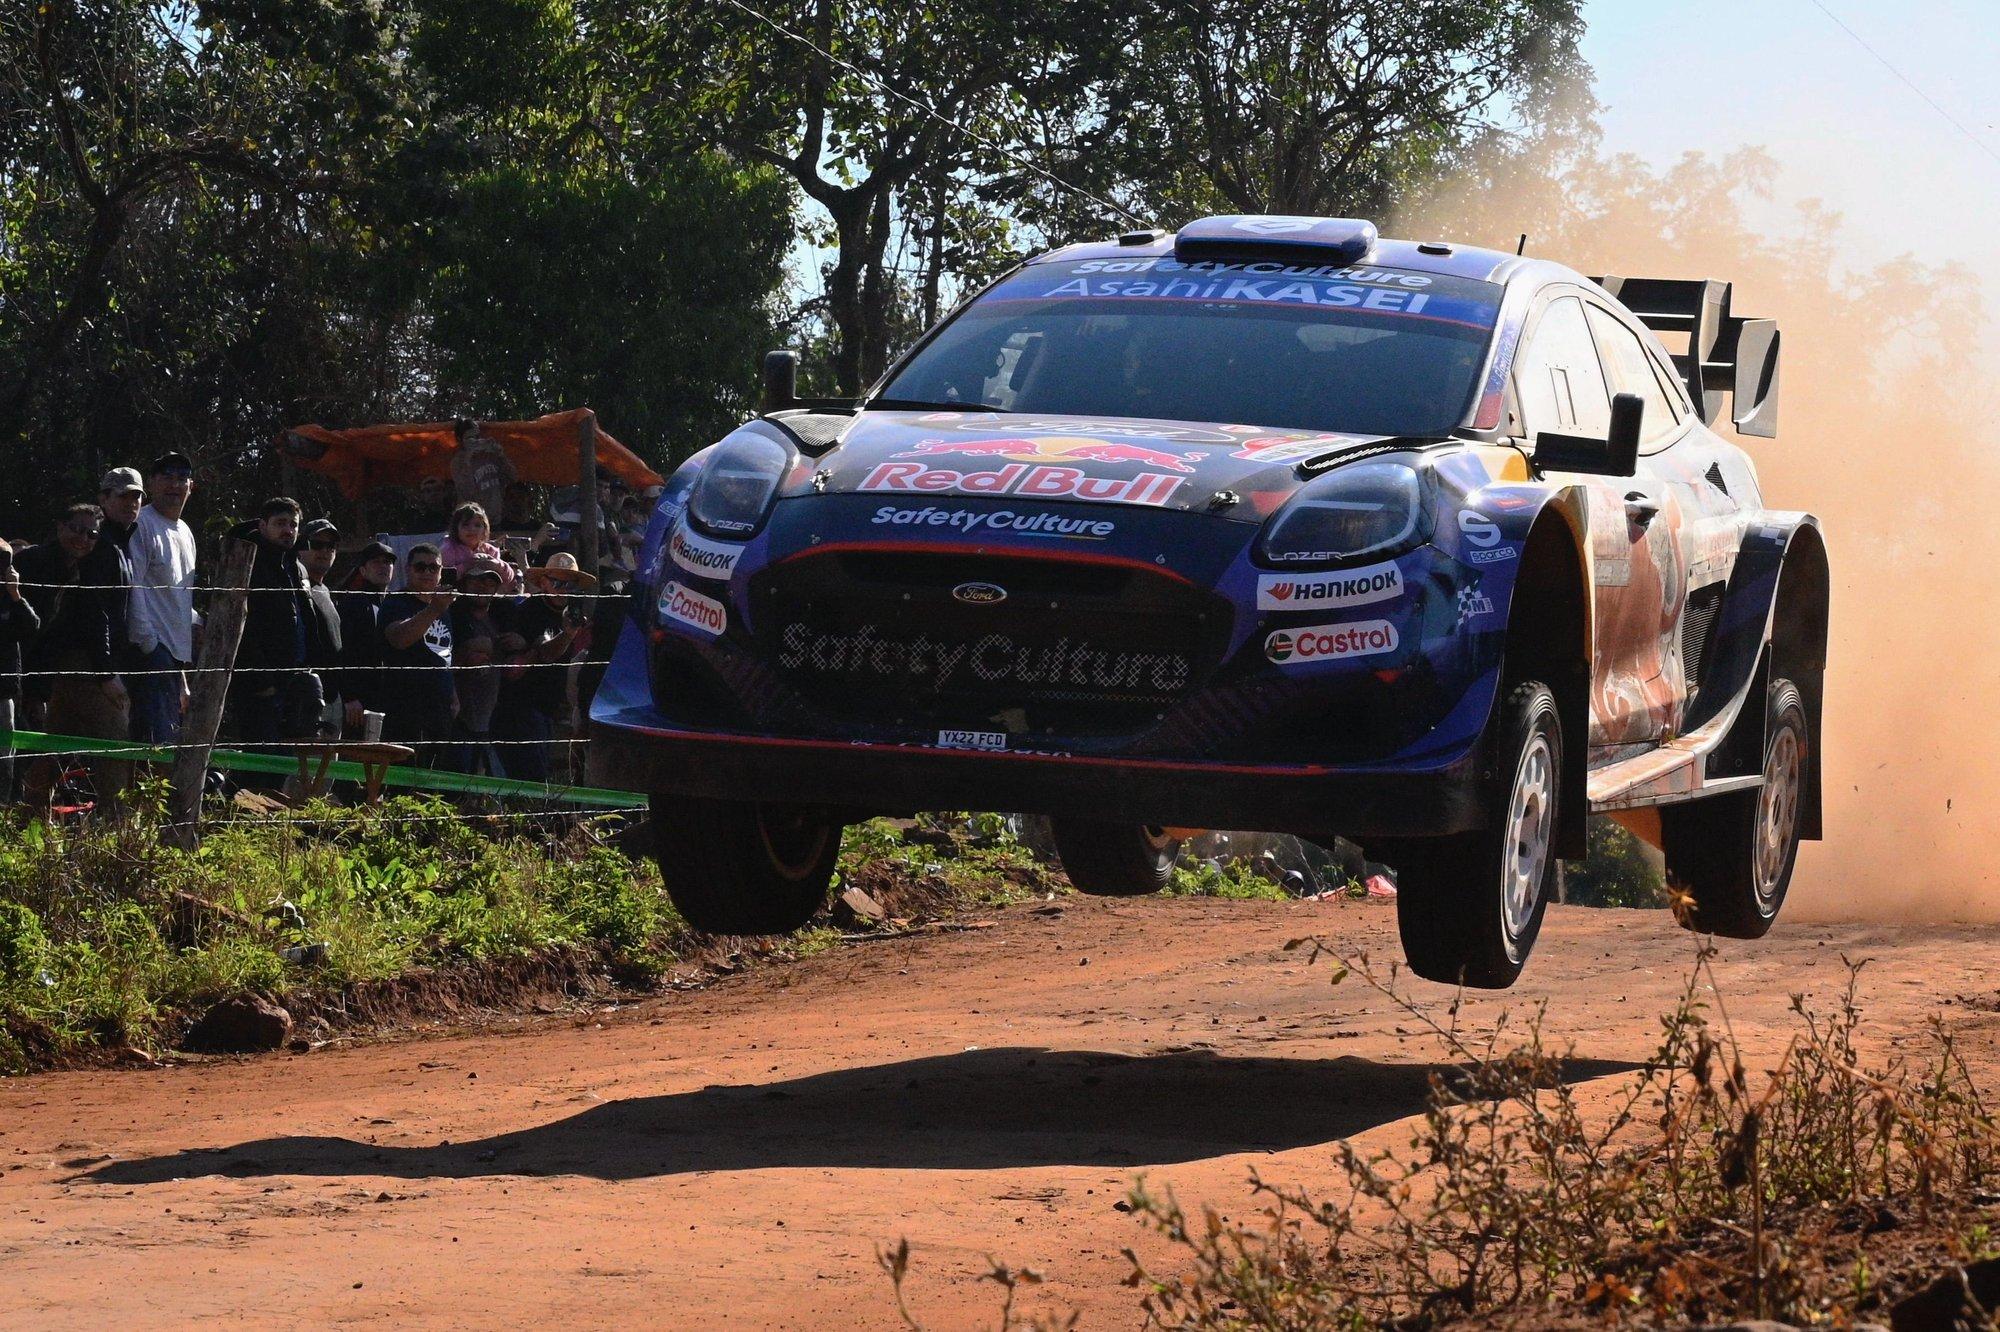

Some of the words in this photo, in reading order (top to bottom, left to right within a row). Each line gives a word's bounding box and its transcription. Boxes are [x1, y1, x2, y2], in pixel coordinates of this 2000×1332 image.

[1071, 259, 1433, 287] SafetyCulture
[857, 462, 1025, 495] Red
[1013, 465, 1187, 505] Bull
[871, 505, 1115, 537] SafetyCulture
[1472, 547, 1514, 562] sparco
[963, 586, 995, 600] Ford
[671, 591, 723, 631] Castrol
[779, 622, 1189, 691] SafetyCulture
[1295, 625, 1393, 657] Castrol
[943, 732, 975, 745] YX22
[979, 733, 1003, 746] FCD
